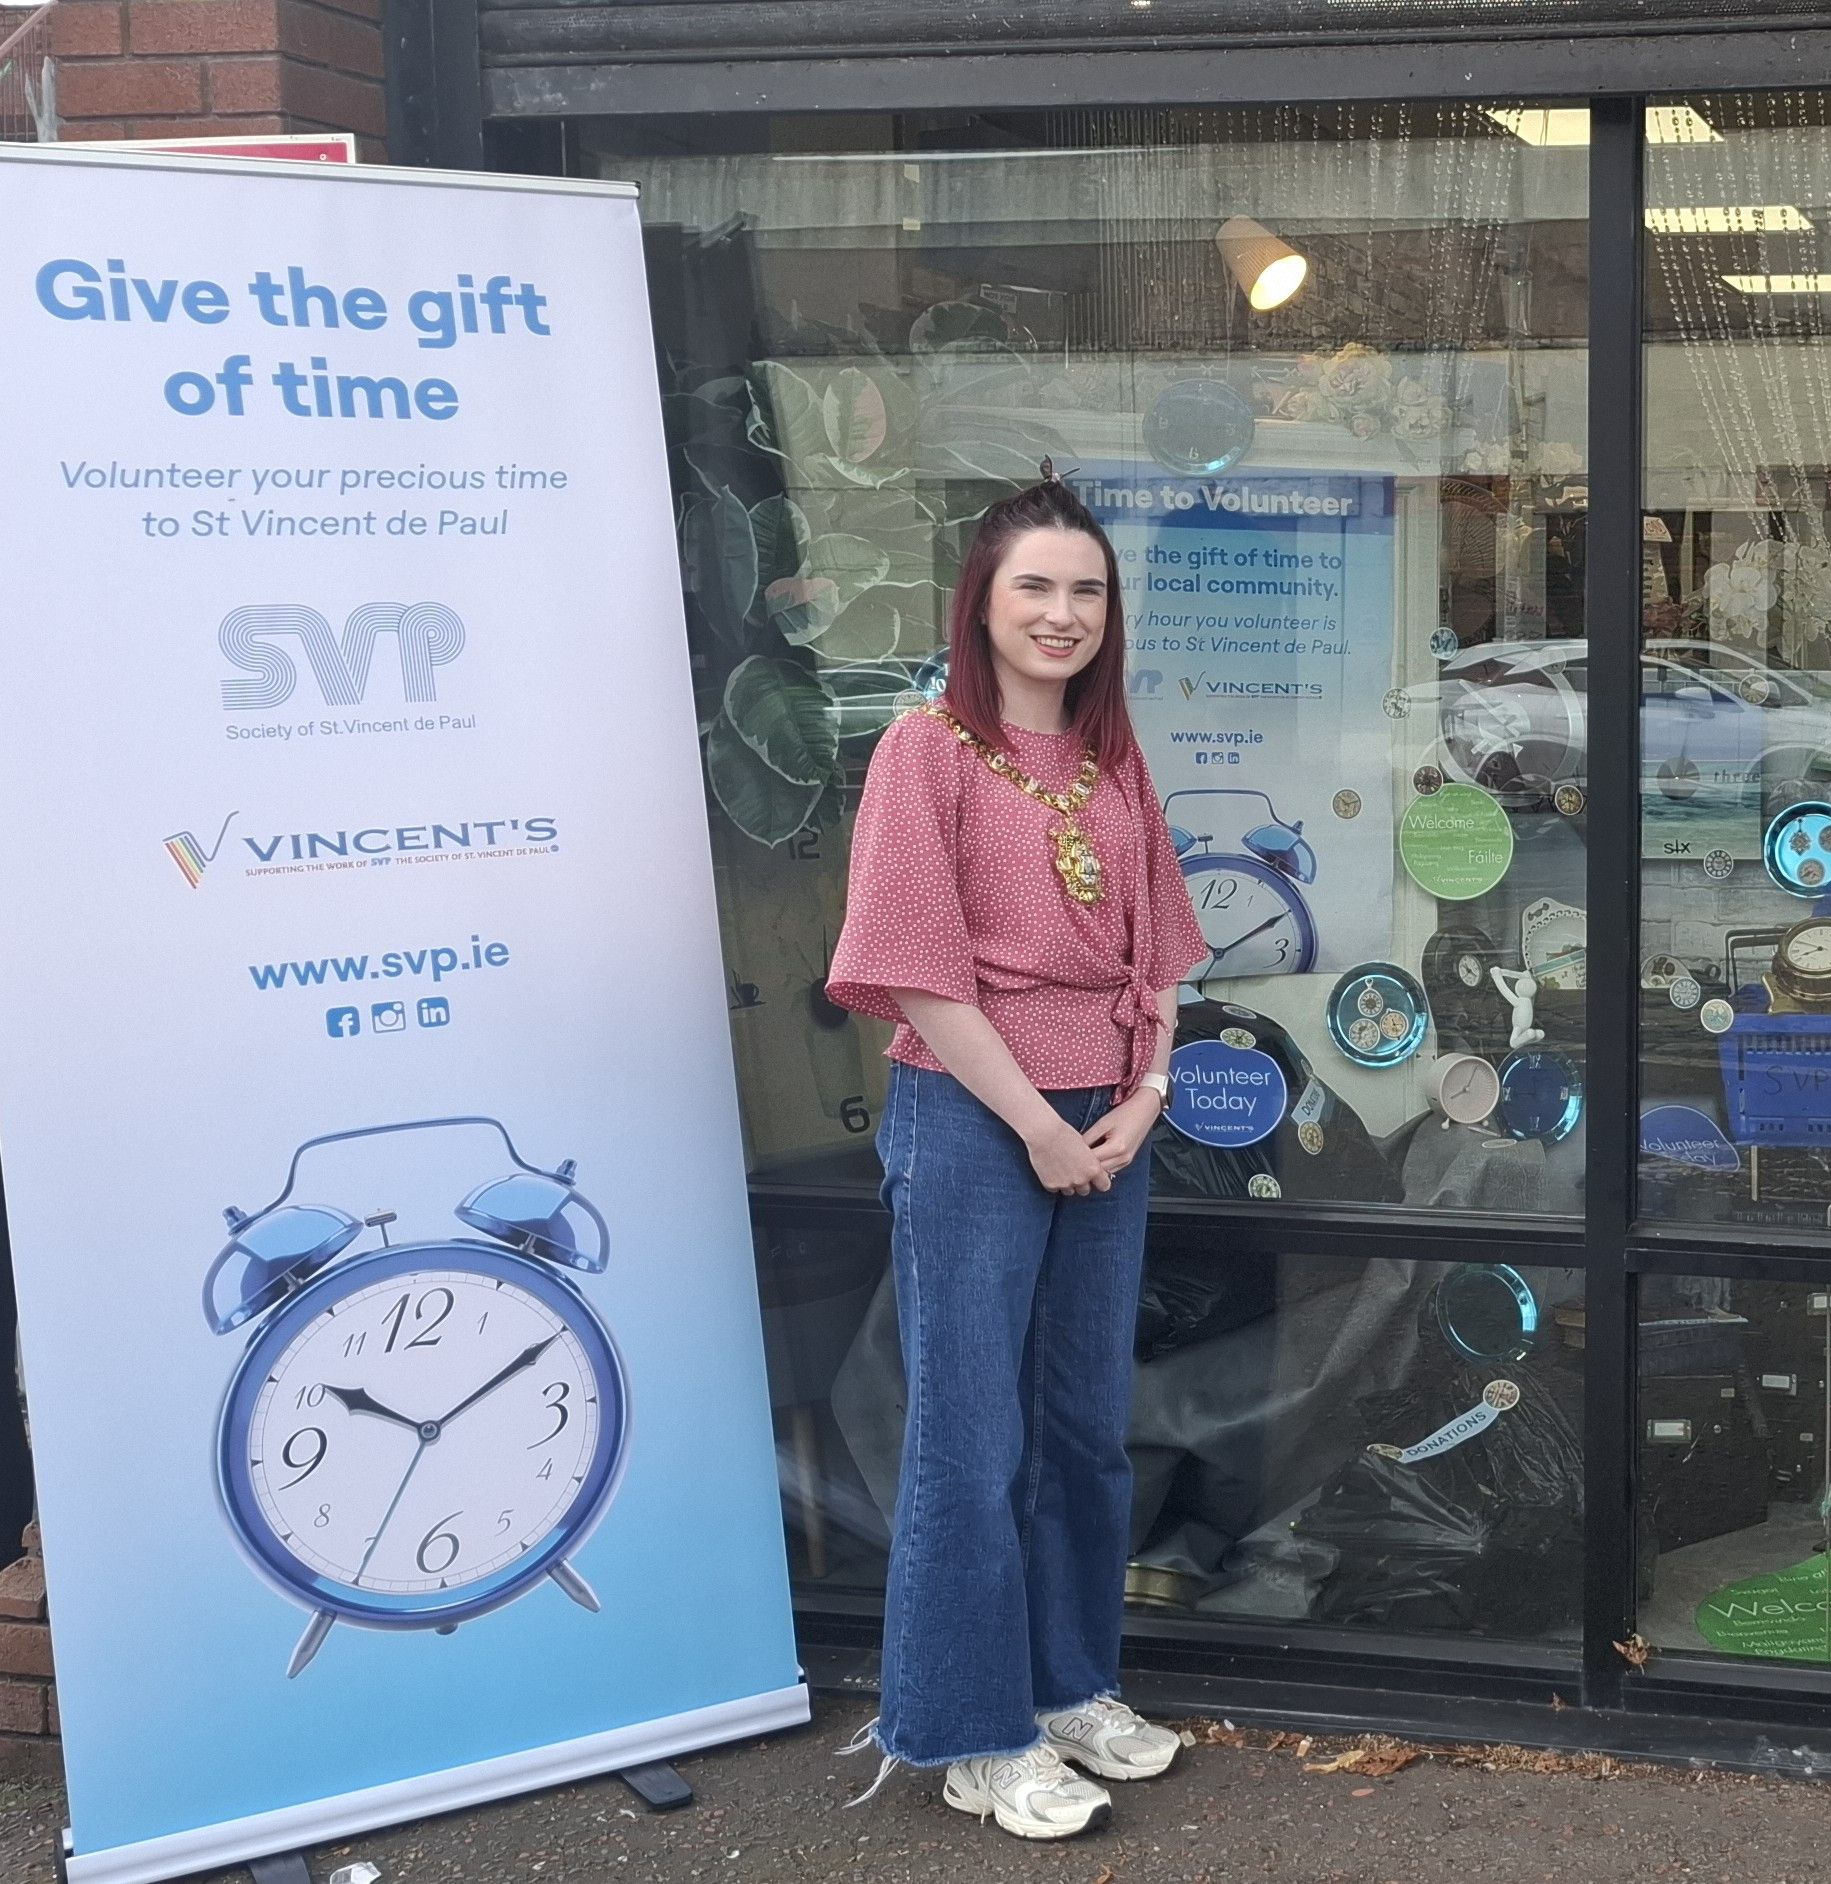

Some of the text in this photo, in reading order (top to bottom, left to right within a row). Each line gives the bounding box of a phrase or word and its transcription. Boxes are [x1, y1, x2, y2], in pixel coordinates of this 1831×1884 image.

[36, 258, 552, 349] Give the gift
[164, 354, 461, 421] of time
[60, 460, 569, 497] Volunteer your precious time
[1073, 480, 1353, 517] Time to Volunteer
[142, 508, 509, 538] to St Vincent de Paul
[1145, 547, 1343, 570] the gift of time to
[1147, 574, 1339, 602] local community.
[1148, 611, 1192, 630] hour
[1195, 614, 1228, 633] you
[1234, 614, 1320, 632] volunteer
[1323, 615, 1337, 632] is
[218, 601, 467, 711] SVP
[1161, 636, 1181, 651] to
[1185, 637, 1205, 652] St
[1211, 637, 1281, 655] Vincent
[1284, 639, 1307, 656] de
[1205, 680, 1323, 696] VINCENT'S
[226, 714, 477, 742] Society of de Paul
[1170, 728, 1264, 748] www.svp.ie
[1713, 769, 1760, 785] three
[1408, 814, 1475, 830] Welcome
[242, 817, 559, 863] VINCENT'S
[1663, 839, 1692, 855] six
[245, 846, 551, 878] SUPPORTING THE WORK OF SVP THE SOCIETY OF VINCENT DE PAUL
[1468, 849, 1504, 865] Fáilte
[1200, 878, 1238, 910] 12
[1247, 894, 1255, 908] 1
[247, 934, 511, 991] www.svp.ie
[1262, 937, 1290, 969] 3
[1168, 1064, 1271, 1086] Volunteer
[840, 1094, 871, 1133] 6
[1184, 1087, 1258, 1118] Today
[381, 1287, 455, 1354] 12
[476, 1311, 489, 1334] 1
[343, 1332, 366, 1358] 11
[295, 1383, 326, 1411] 10
[527, 1382, 570, 1450] 3
[1406, 1409, 1488, 1458] DONATIONS
[278, 1426, 328, 1491] 9
[536, 1458, 554, 1481] 4
[314, 1503, 331, 1528] 8
[494, 1509, 514, 1537] 5
[416, 1511, 464, 1574] 6
